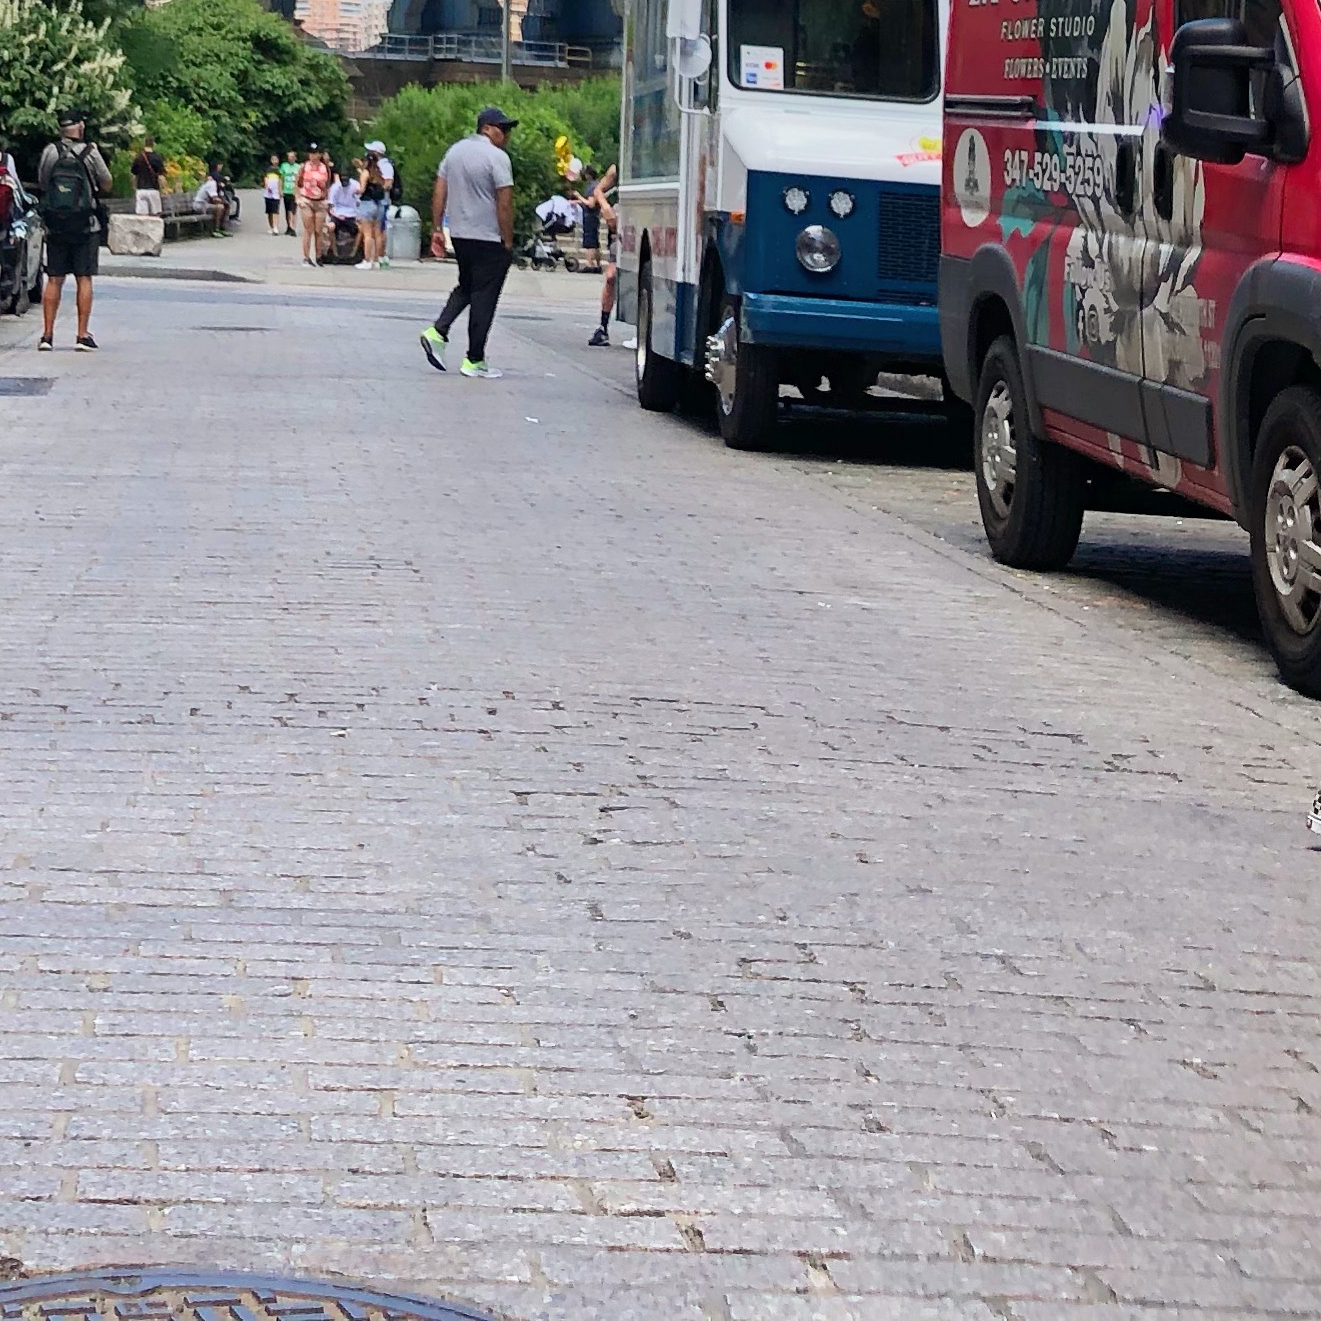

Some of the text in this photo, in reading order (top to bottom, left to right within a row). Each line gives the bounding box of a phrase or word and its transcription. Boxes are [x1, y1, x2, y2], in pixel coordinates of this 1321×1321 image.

[1000, 15, 1096, 42] FLOWER STUDIO
[1003, 148, 1104, 198] 347-529-5259
